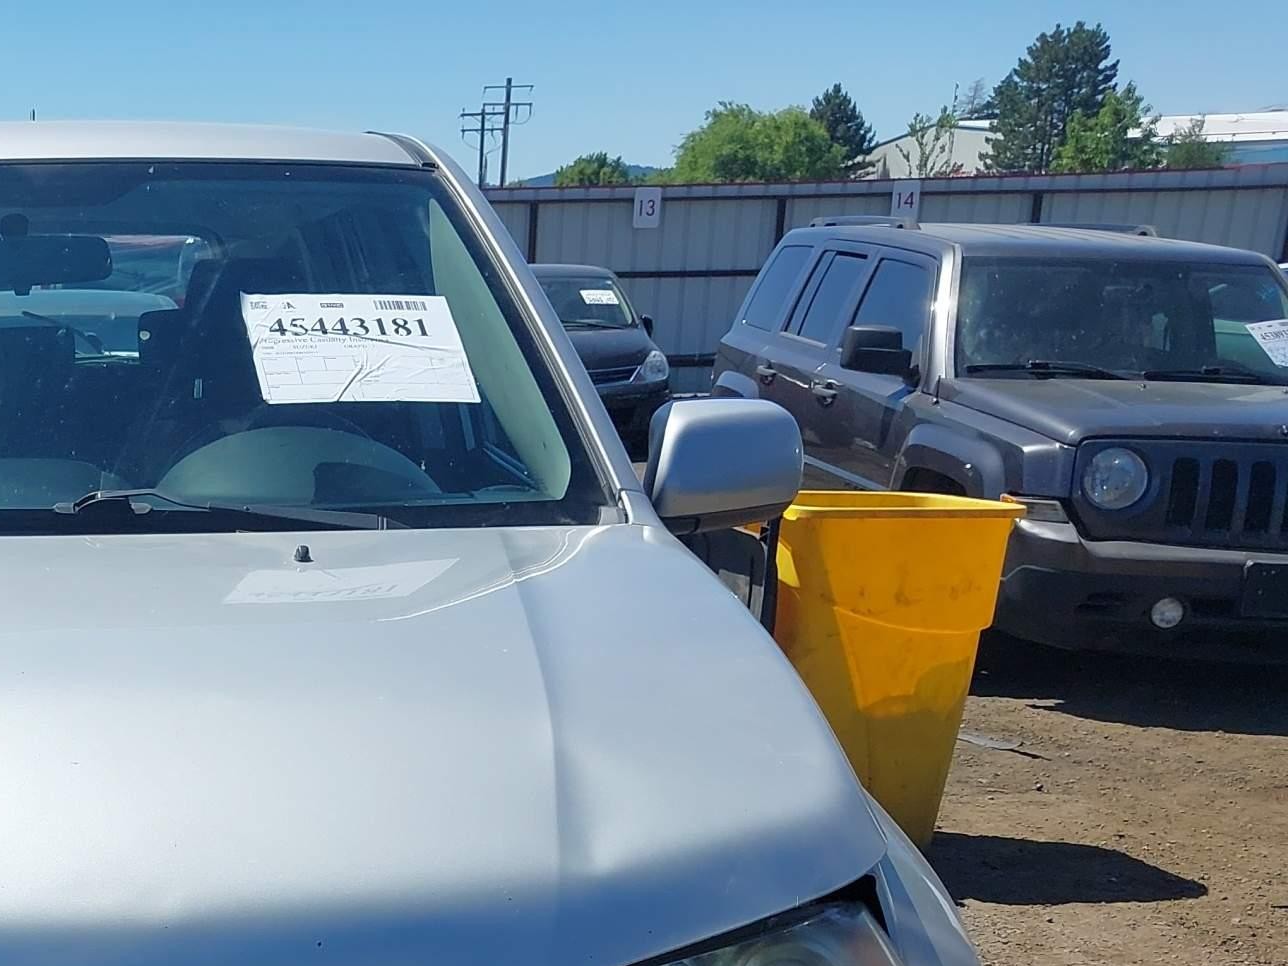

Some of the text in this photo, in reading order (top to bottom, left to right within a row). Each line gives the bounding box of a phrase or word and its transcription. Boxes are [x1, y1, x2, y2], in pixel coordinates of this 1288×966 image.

[639, 199, 655, 216] 13
[897, 191, 914, 209] 14
[269, 317, 430, 337] 45443181
